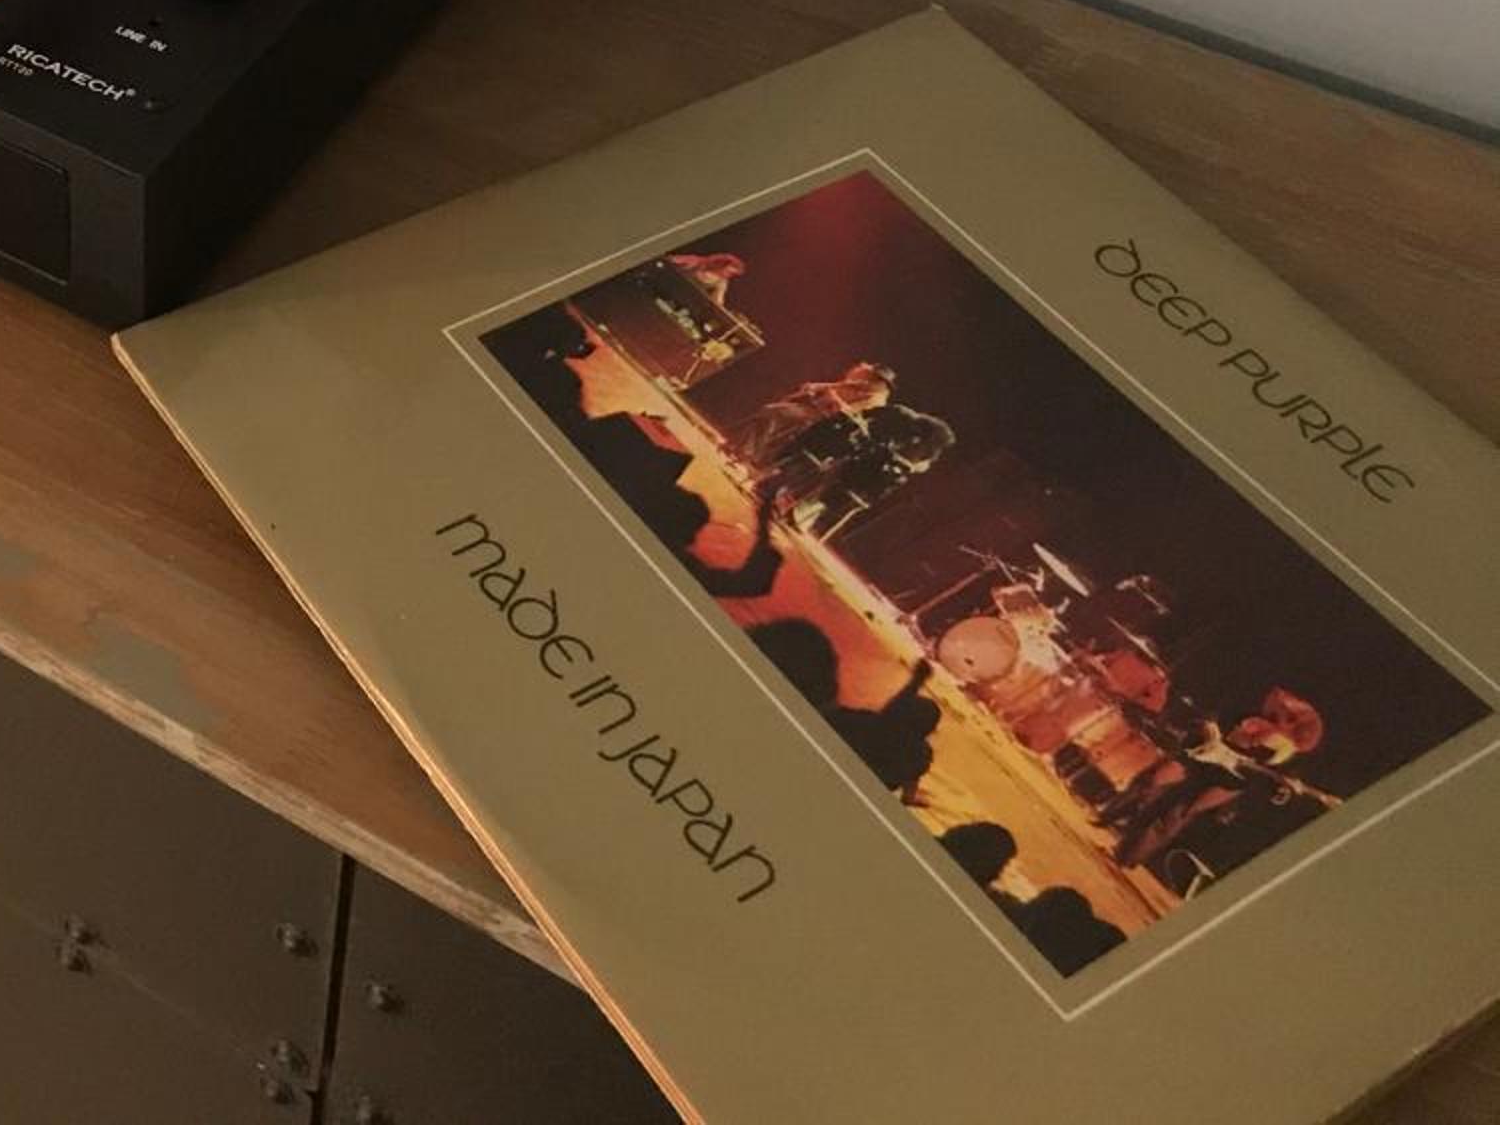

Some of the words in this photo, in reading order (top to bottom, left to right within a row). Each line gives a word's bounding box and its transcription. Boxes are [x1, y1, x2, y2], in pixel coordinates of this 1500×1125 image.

[114, 25, 147, 44] LINE
[148, 39, 169, 52] IN
[1093, 237, 1233, 347] DEEP
[1218, 348, 1416, 504] PURPLE
